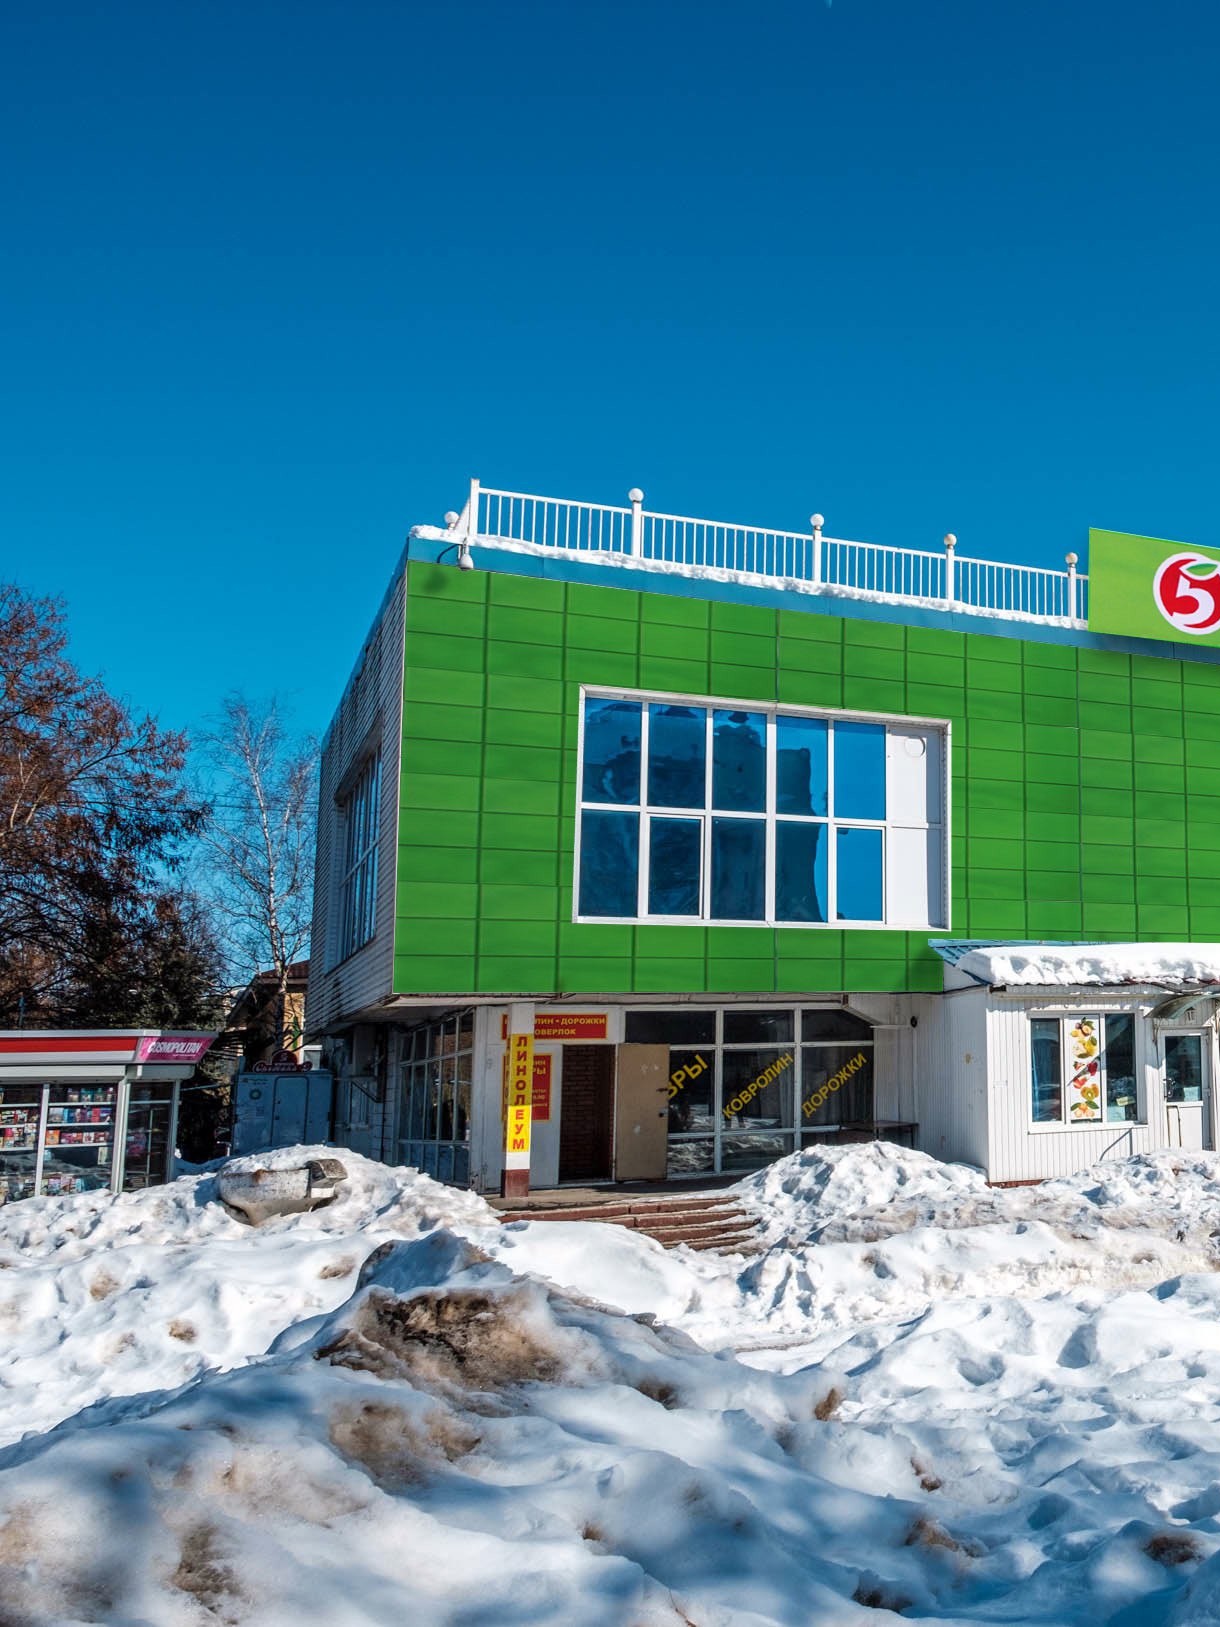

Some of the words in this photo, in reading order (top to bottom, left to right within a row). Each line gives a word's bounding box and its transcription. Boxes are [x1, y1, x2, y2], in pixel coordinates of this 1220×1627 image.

[513, 1036, 528, 1150] ЛИНОЛЕУМ
[667, 1054, 708, 1099] ВРЫ
[722, 1052, 794, 1118] КОВРОЛИН
[801, 1052, 867, 1118] ДОРОЖКИ
